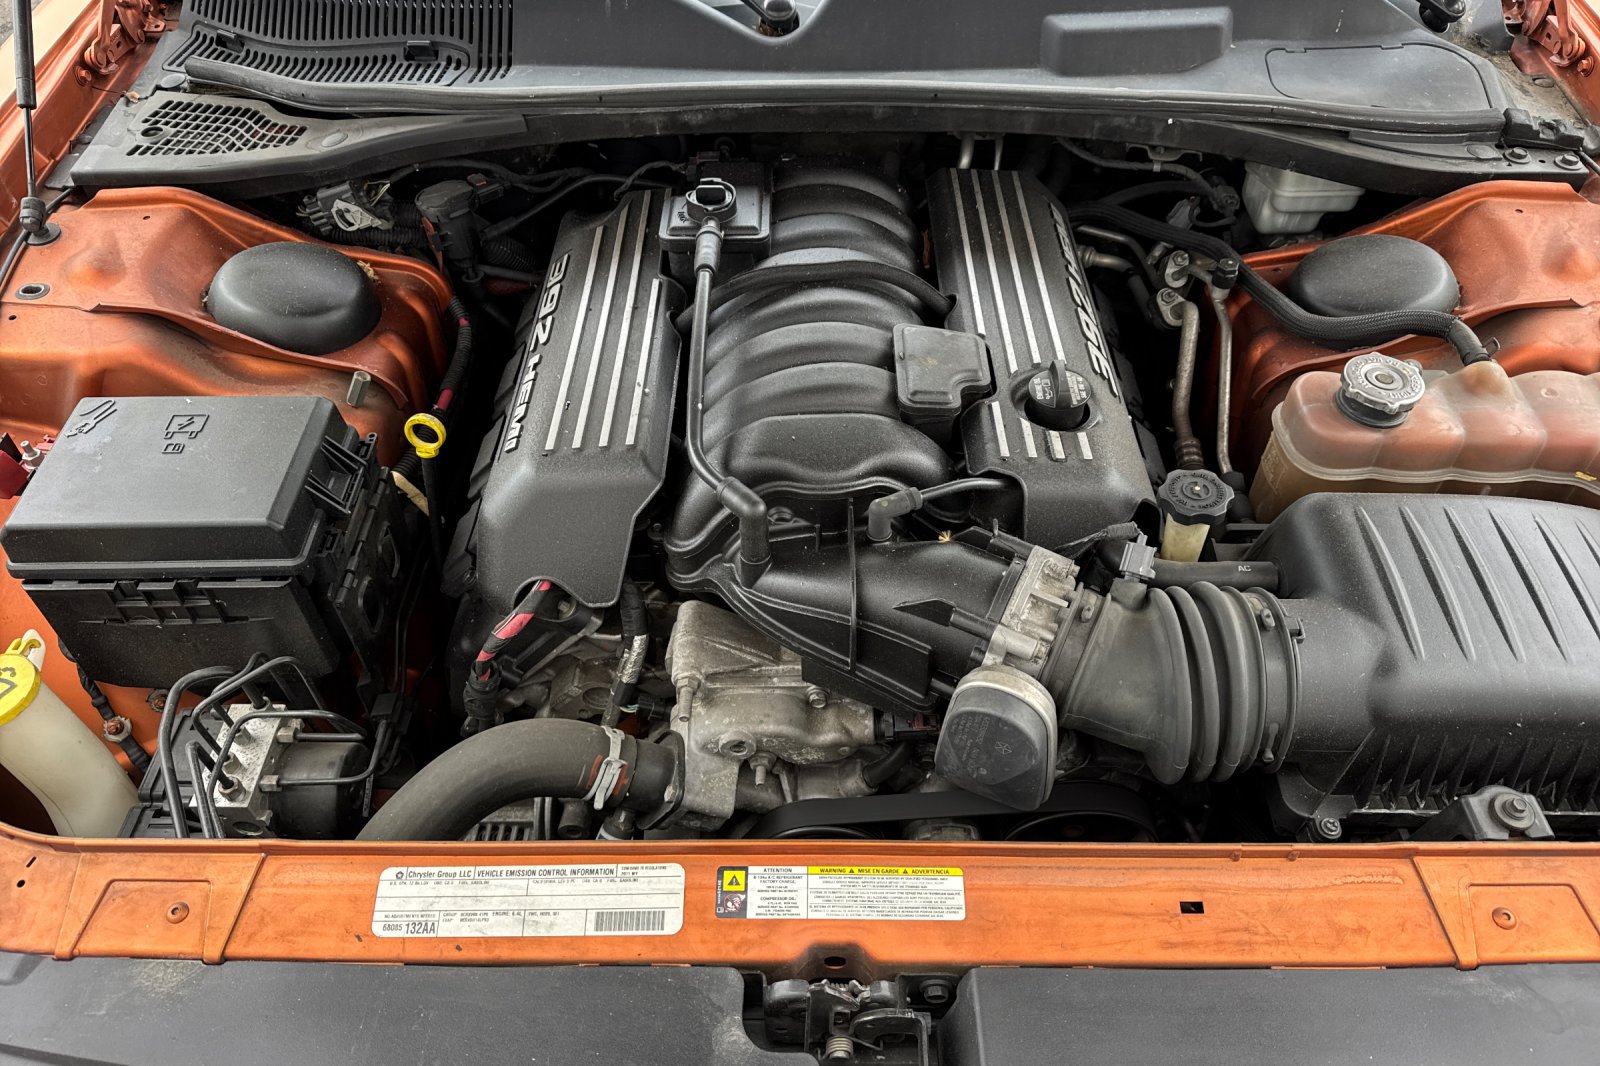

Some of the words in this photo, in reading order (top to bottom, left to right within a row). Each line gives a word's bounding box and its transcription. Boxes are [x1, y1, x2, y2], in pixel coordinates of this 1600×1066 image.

[1048, 202, 1082, 286] HEMI
[529, 253, 570, 352] 392
[1066, 277, 1118, 398] 392
[504, 353, 542, 453] HEMI
[408, 870, 436, 879] Chrysler
[438, 870, 457, 878] Group
[406, 922, 435, 934] 132AA
